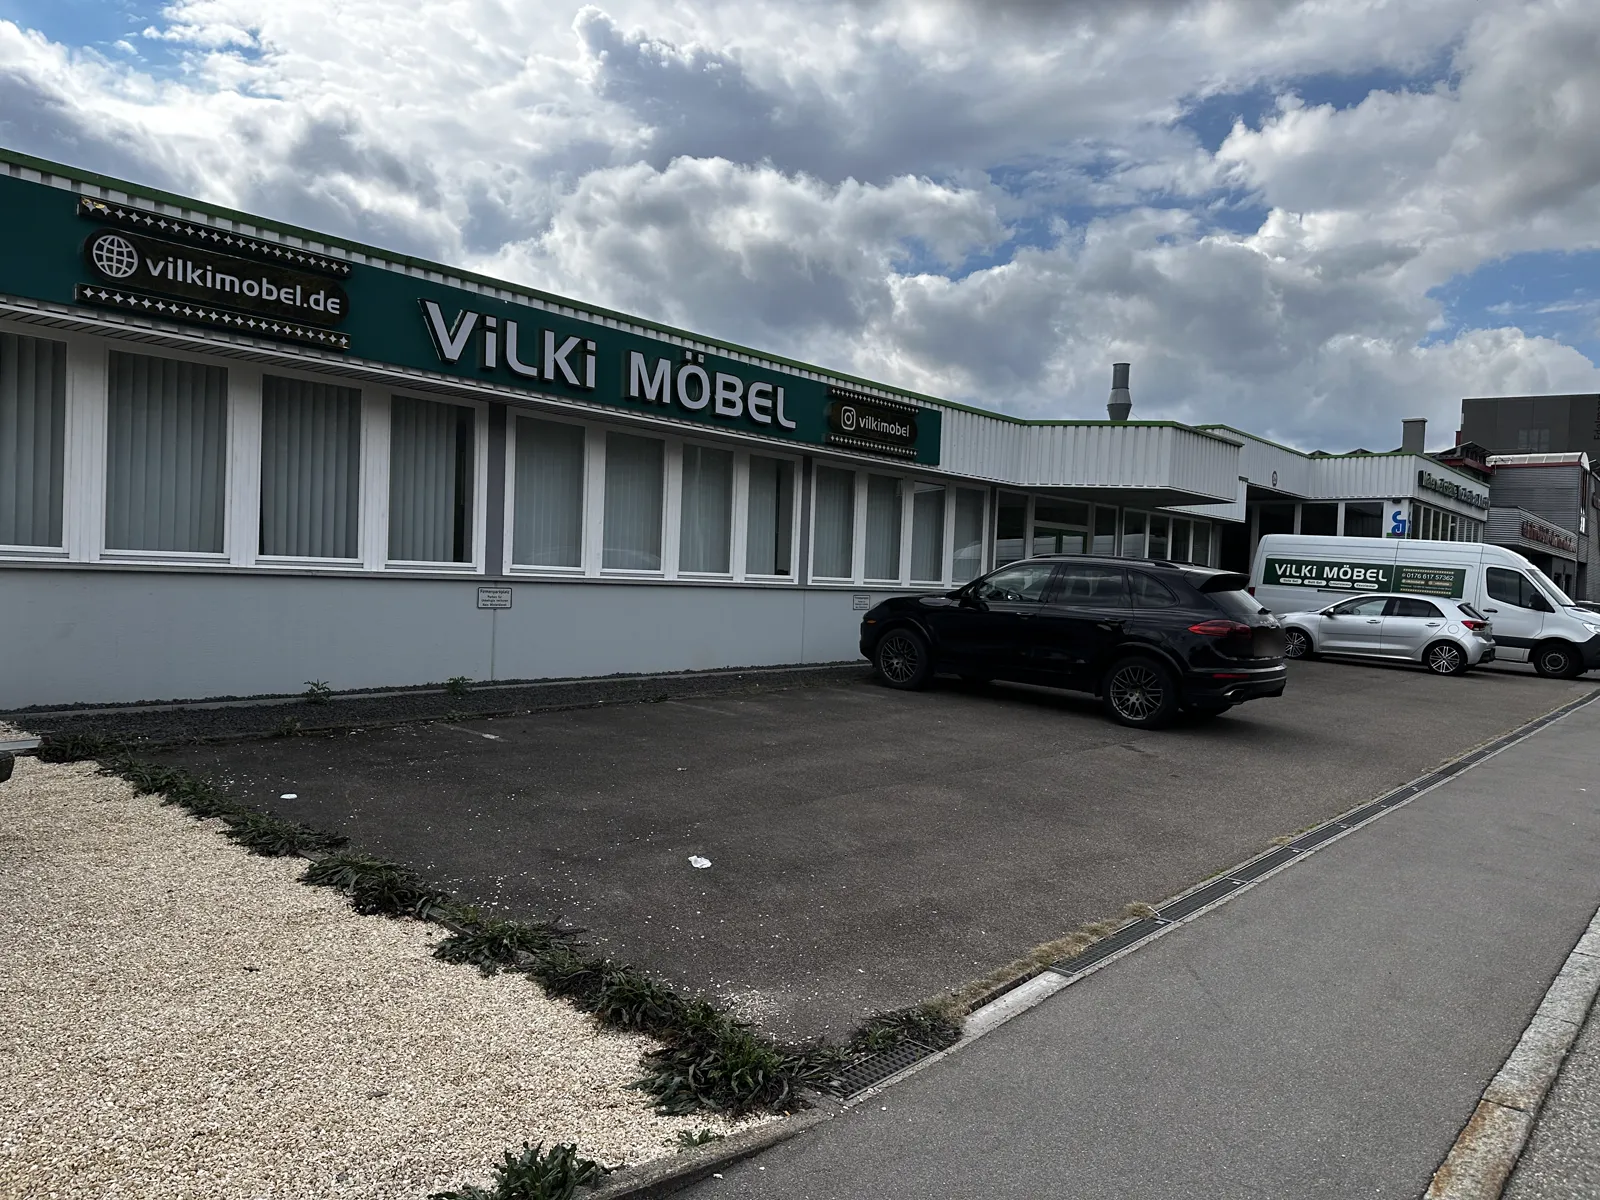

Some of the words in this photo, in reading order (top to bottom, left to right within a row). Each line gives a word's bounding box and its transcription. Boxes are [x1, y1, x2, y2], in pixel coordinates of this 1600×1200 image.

[145, 256, 340, 315] vilkimobel.de
[418, 298, 597, 389] ViLKi
[628, 350, 796, 429] MÖBEL
[858, 414, 910, 439] vilkimobel
[1323, 565, 1387, 582] MÖBEL
